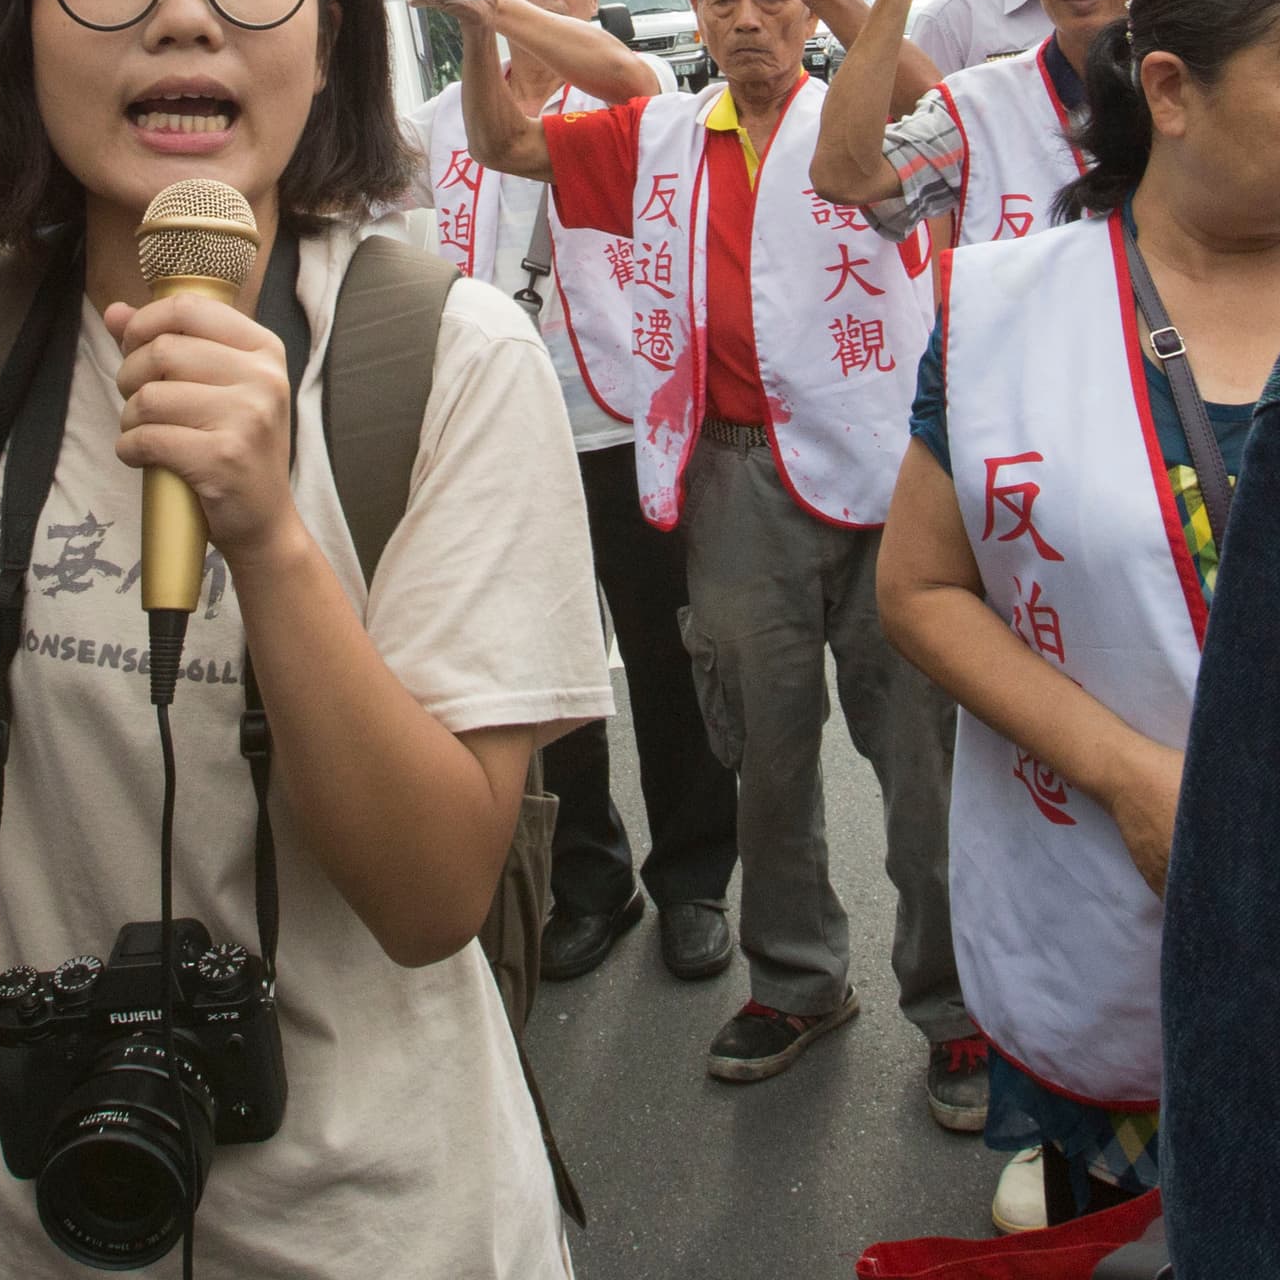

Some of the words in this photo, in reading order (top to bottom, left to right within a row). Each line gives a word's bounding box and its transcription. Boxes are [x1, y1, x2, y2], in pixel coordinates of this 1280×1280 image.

[435, 149, 477, 278] 反迫
[632, 173, 683, 372] 反迫遷
[21, 628, 151, 675] ONSENSE
[207, 1012, 240, 1021] X-T2
